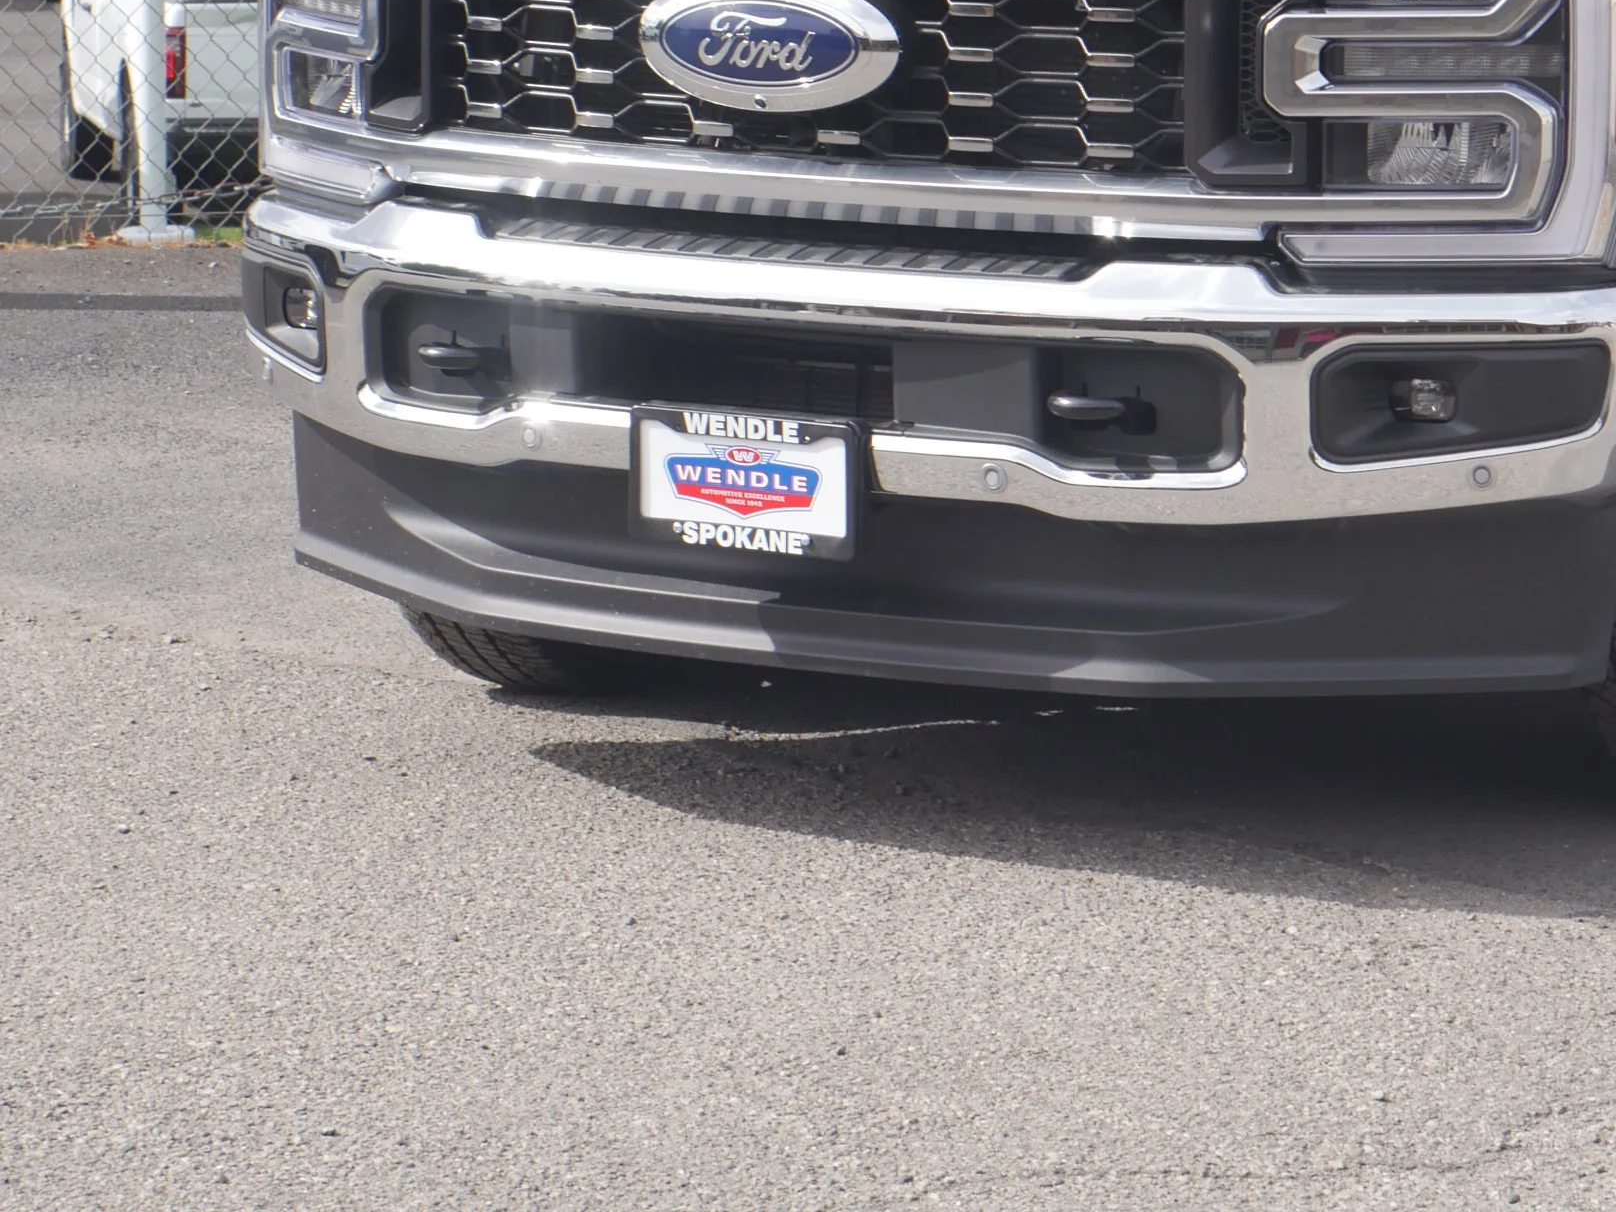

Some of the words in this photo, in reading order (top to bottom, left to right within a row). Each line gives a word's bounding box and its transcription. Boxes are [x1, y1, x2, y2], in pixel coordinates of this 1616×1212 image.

[698, 10, 816, 71] Ford
[683, 412, 800, 444] WENDLE
[675, 464, 808, 493] WENDLE
[701, 488, 743, 498] AUTOMOTIVE
[744, 492, 785, 502] EXCELLENCE
[682, 521, 804, 555] SPOKANE
